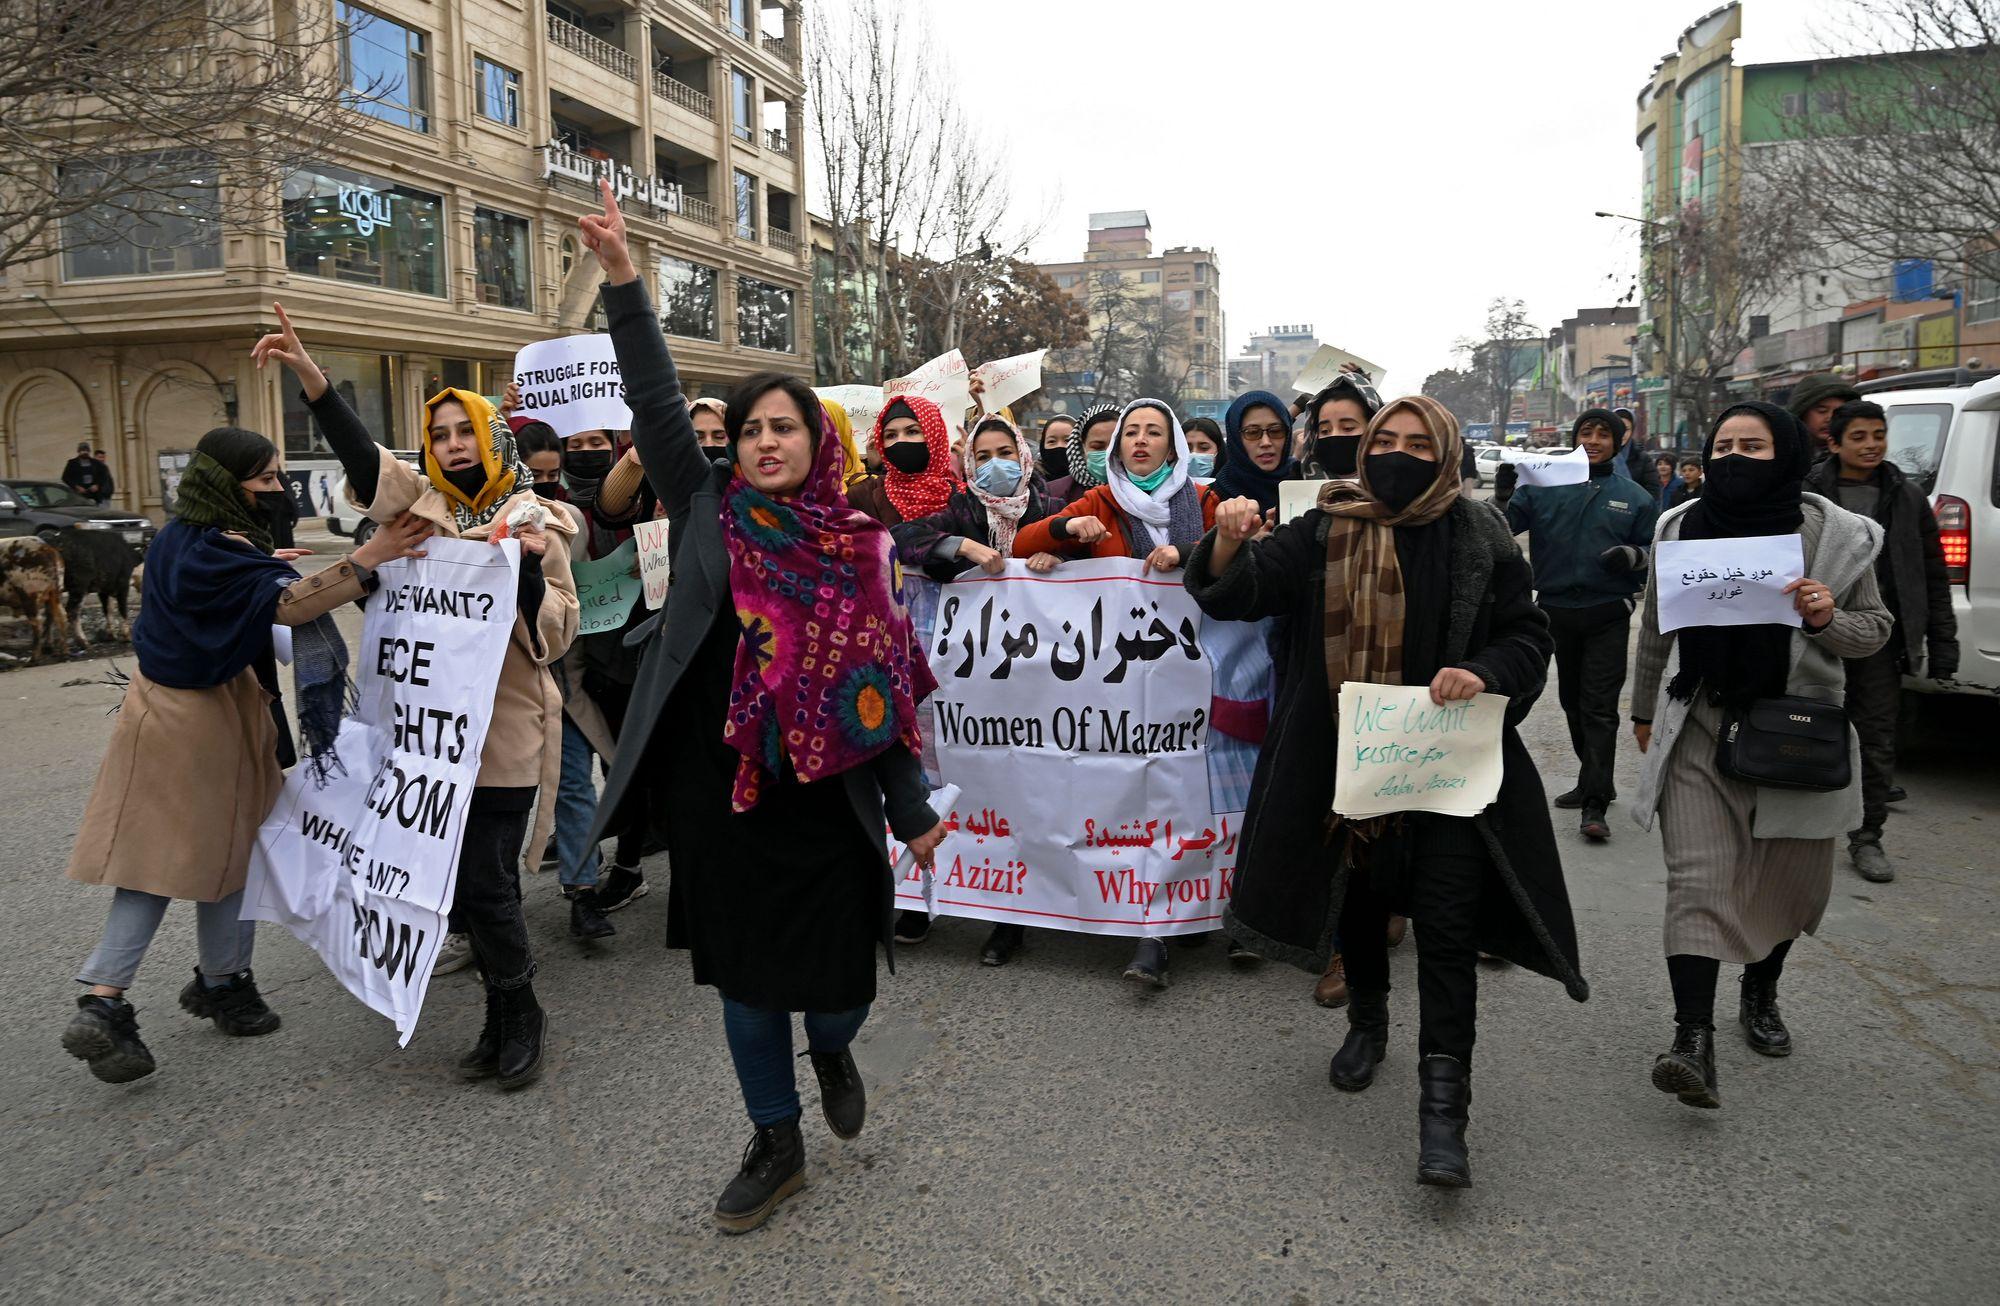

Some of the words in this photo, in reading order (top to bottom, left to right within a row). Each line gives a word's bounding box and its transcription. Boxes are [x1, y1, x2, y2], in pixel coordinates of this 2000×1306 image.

[517, 363, 585, 387] STRUGGLE
[590, 361, 621, 376] FOR
[516, 388, 568, 410] EQUAL
[570, 381, 627, 402] RIGHTS
[937, 595, 1038, 679] مزار؟
[1051, 595, 1202, 683] دختران
[934, 700, 1044, 748] Women
[1052, 705, 1092, 752] Of
[1099, 707, 1205, 755] Mazar?
[1355, 696, 1397, 734] We
[1351, 741, 1418, 771] justice
[1418, 747, 1452, 768] for
[965, 807, 1010, 844] عالیه
[1085, 818, 1158, 856] کشتید؟
[1165, 819, 1217, 861] چرا
[944, 854, 1028, 895] Azizi?
[1094, 868, 1159, 916] Why
[1165, 876, 1211, 915] you
